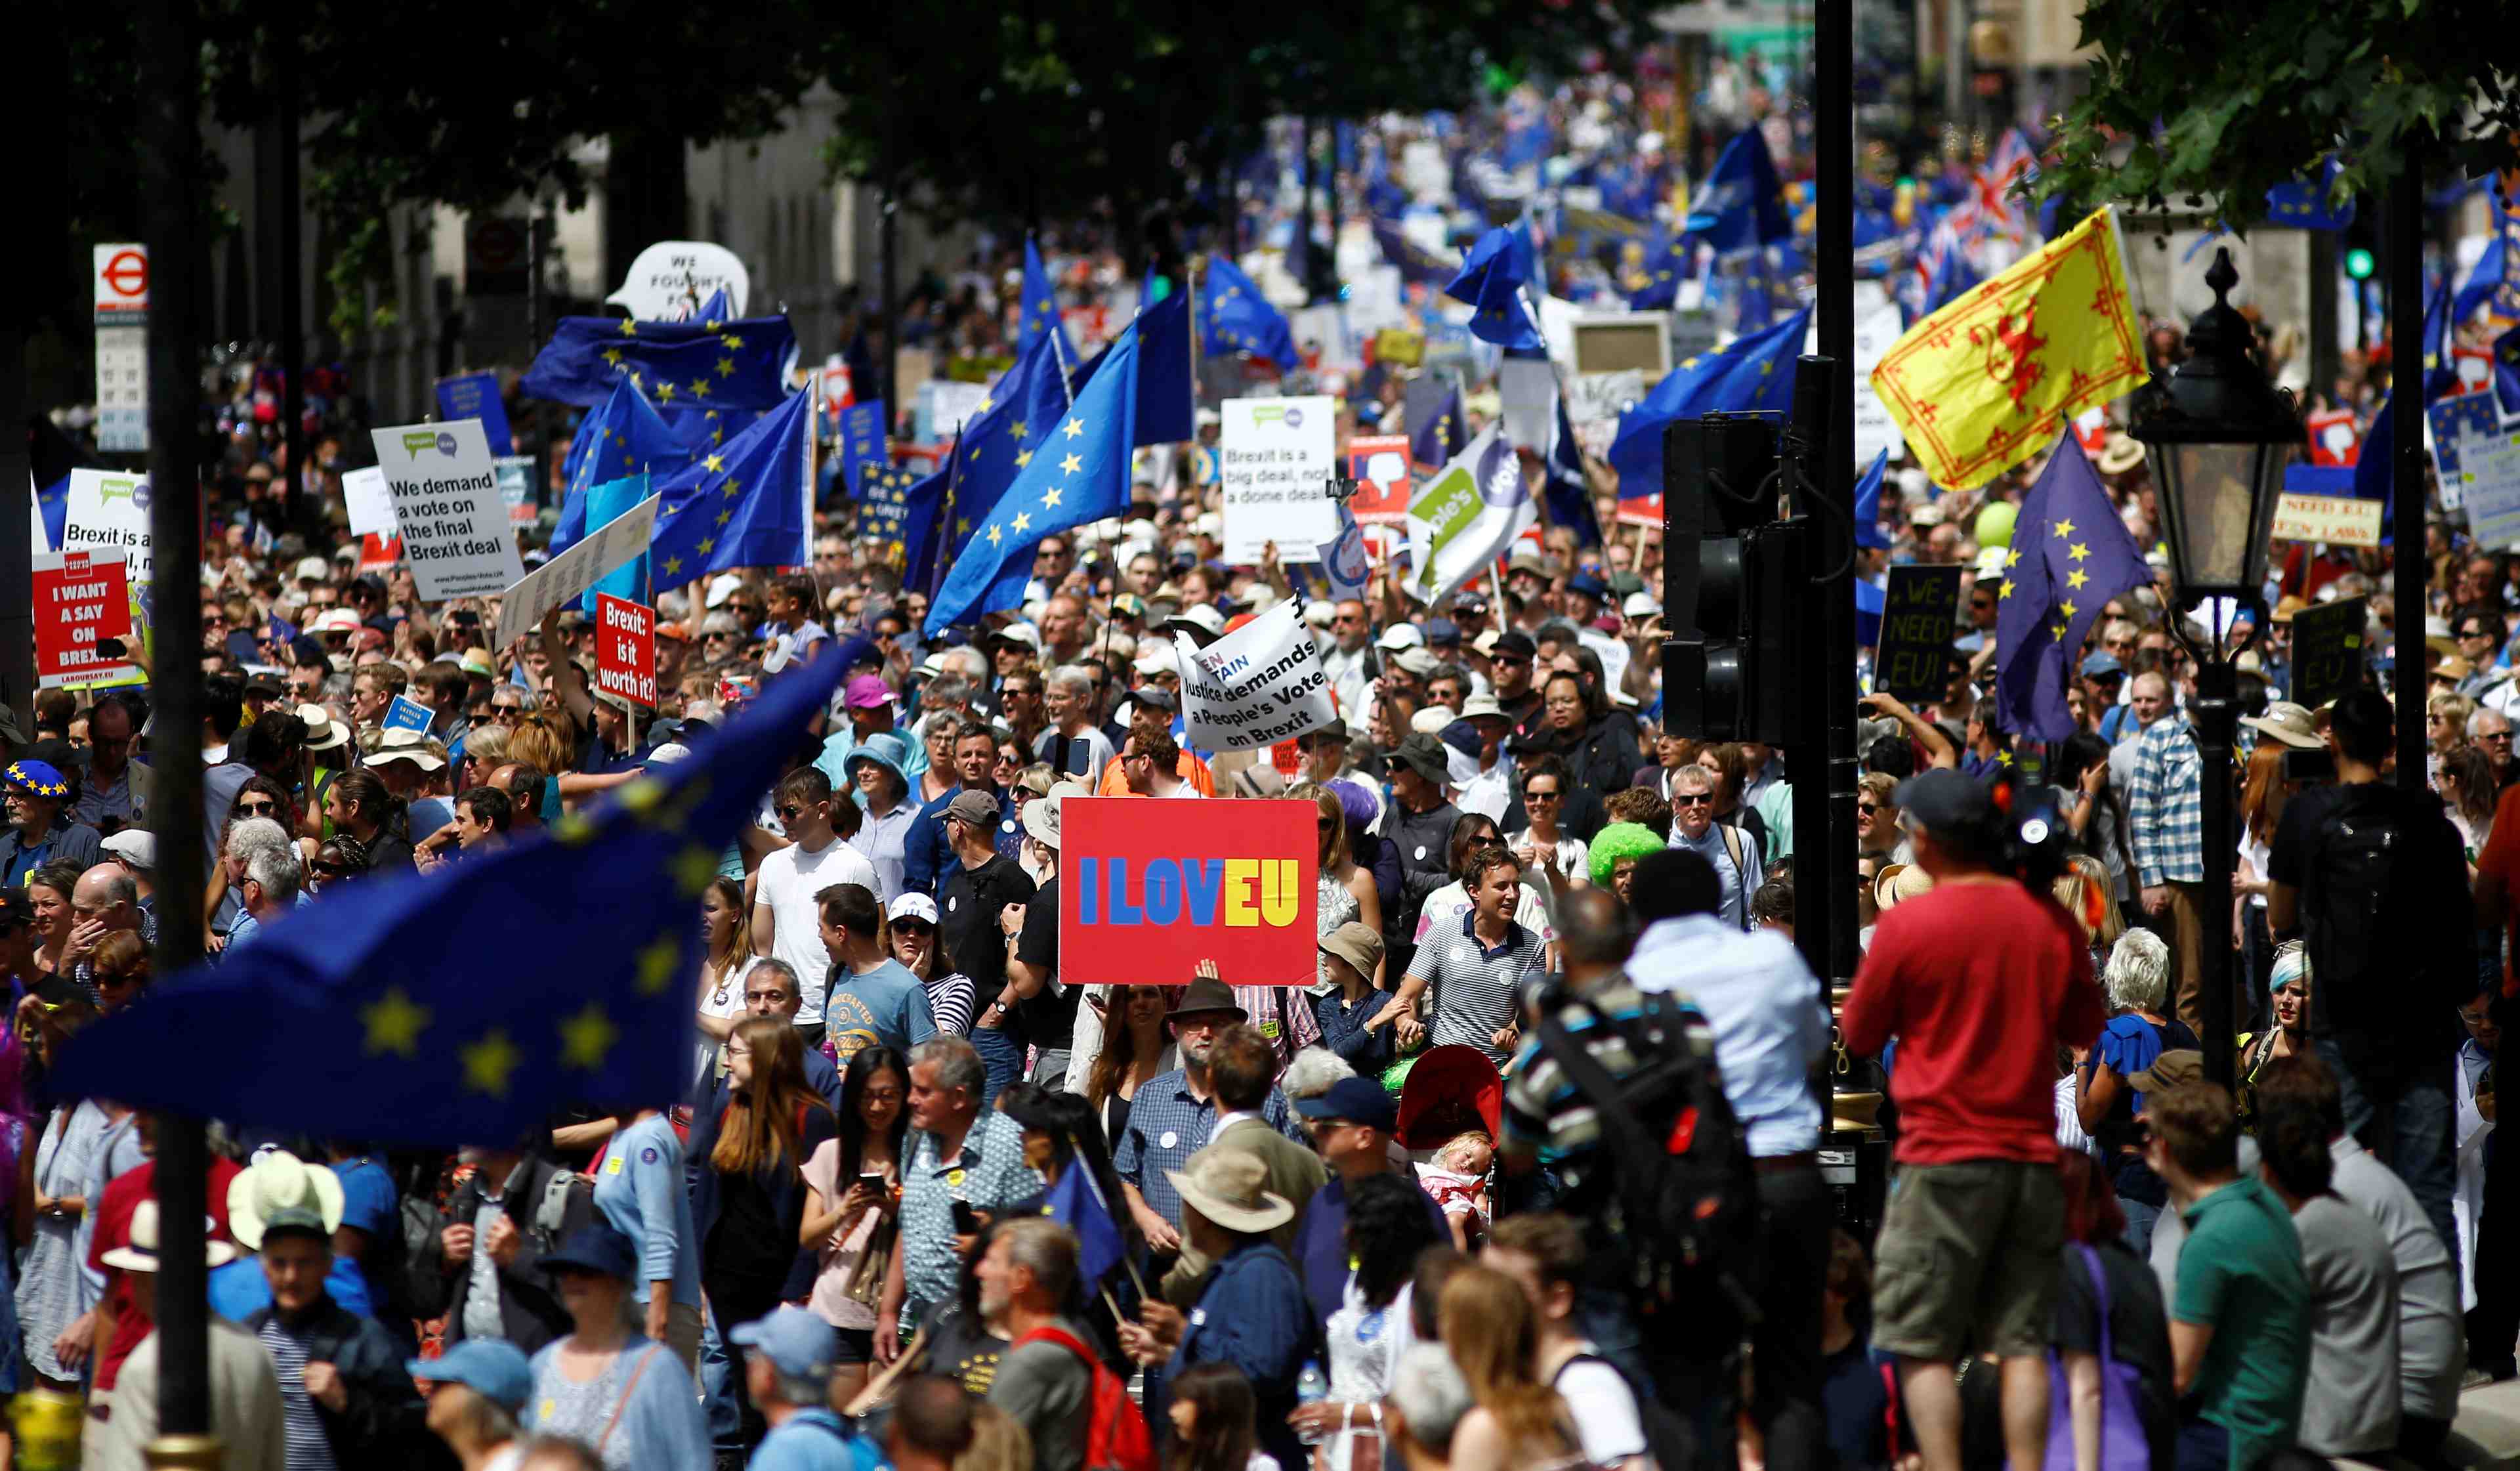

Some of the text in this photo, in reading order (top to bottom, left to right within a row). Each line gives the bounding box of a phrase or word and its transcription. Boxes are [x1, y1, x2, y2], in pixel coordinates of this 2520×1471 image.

[1227, 448, 1308, 463] Brexit is a
[389, 472, 494, 498] We demand
[1226, 469, 1252, 486] big
[1301, 467, 1330, 480] not
[398, 498, 475, 519] a vote on
[1228, 493, 1236, 504] a
[1240, 489, 1283, 504] done
[67, 523, 151, 547] Brexit is a
[403, 517, 474, 541] the final
[409, 536, 502, 561] Brexit deal
[52, 582, 108, 603] I WANT
[1908, 577, 1943, 605] WE
[60, 604, 104, 624] A SAY
[606, 601, 646, 637] Brexit:
[72, 627, 96, 643] ON
[1890, 613, 1951, 643] NEED
[58, 647, 113, 668] BREX
[617, 635, 638, 667] is it
[1199, 652, 1225, 673] EN
[61, 671, 114, 684] LABOURSAY.EU
[1184, 640, 1316, 703] Justice demands
[1213, 654, 1250, 683] TAIN
[600, 667, 654, 702] worth it?
[1192, 670, 1324, 728] a People's Vote
[1226, 710, 1313, 747] on Brexit
[1080, 857, 1299, 927] I LOVEU
